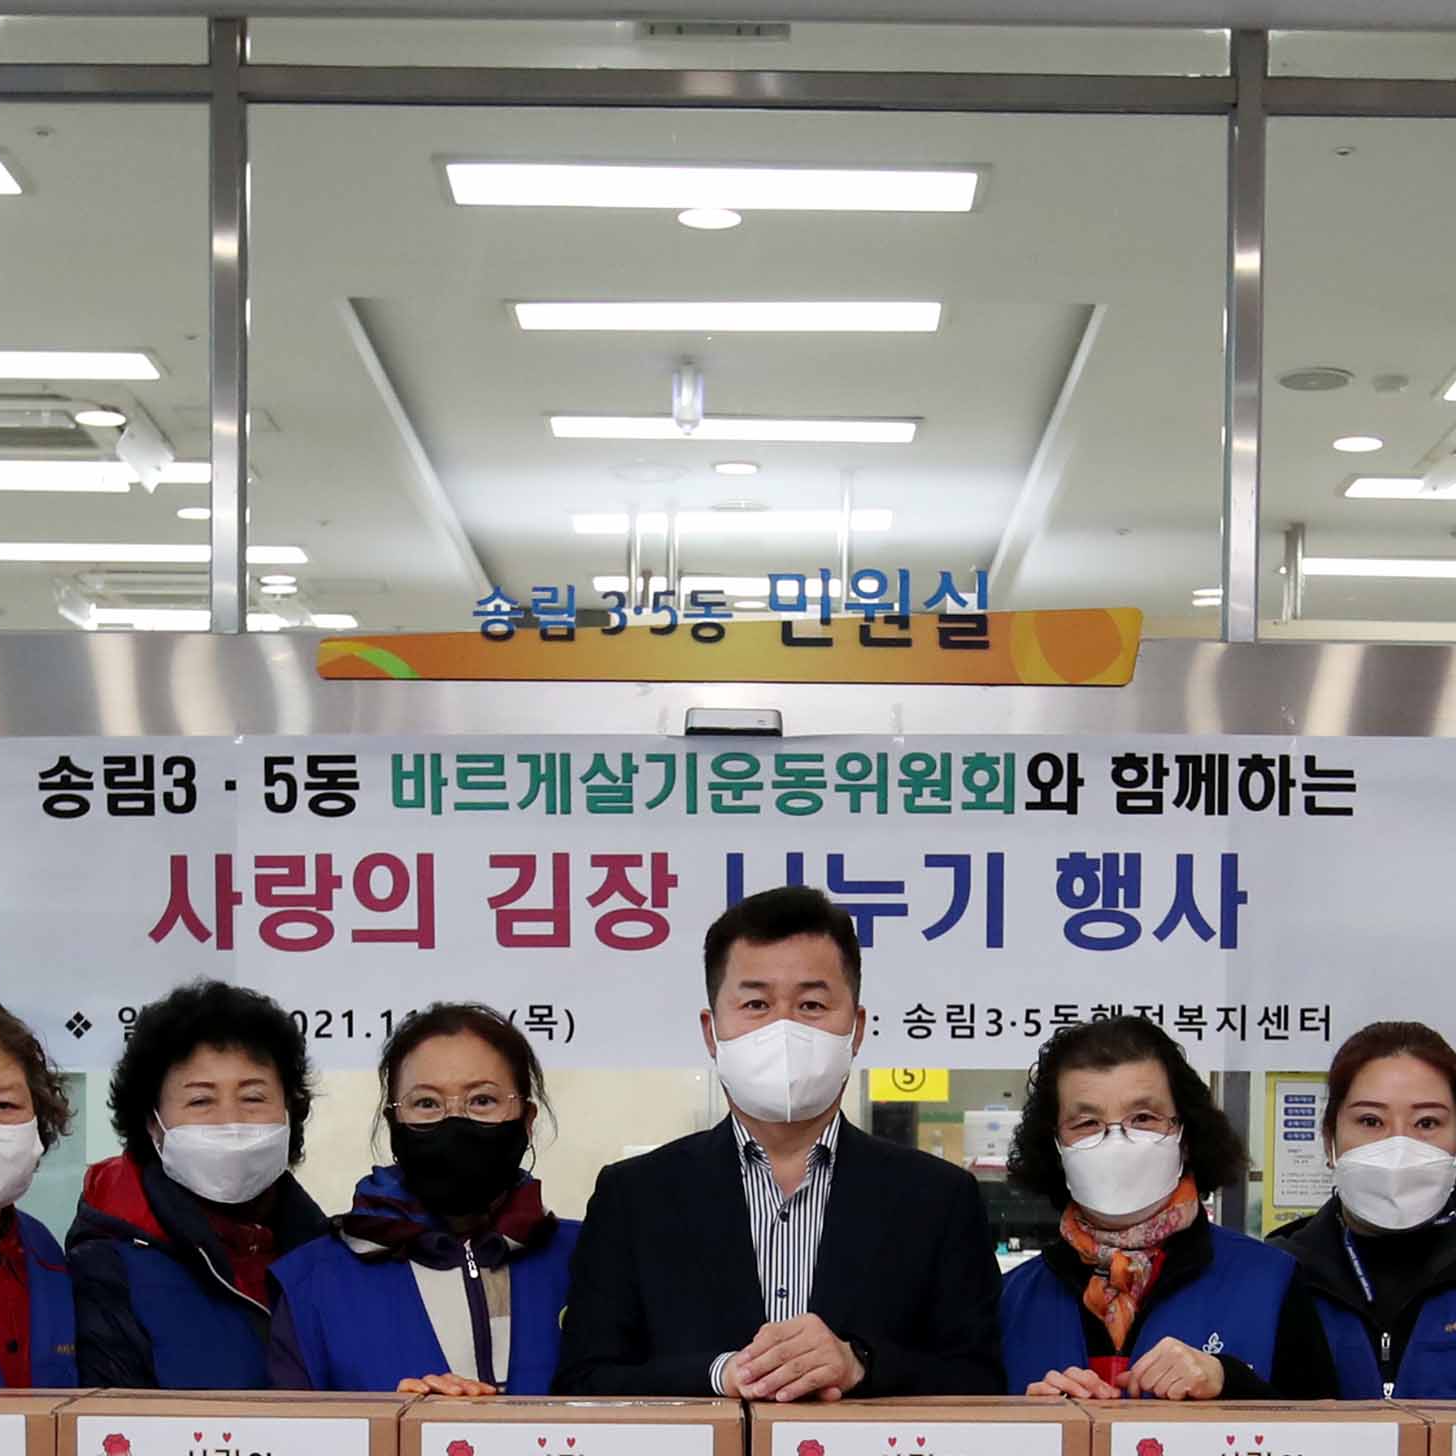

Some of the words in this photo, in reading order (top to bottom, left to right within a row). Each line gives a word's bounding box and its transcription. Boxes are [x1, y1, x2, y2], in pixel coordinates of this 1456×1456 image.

[473, 585, 577, 642] 송림
[601, 589, 734, 644] 3·5동
[768, 568, 990, 650] 민원실
[391, 752, 1084, 816] 바르게살기운동위원회와
[1110, 753, 1357, 817] 함께하는
[148, 852, 436, 952] 사랑의
[488, 852, 678, 951] 김장
[1055, 851, 1248, 951] 행사
